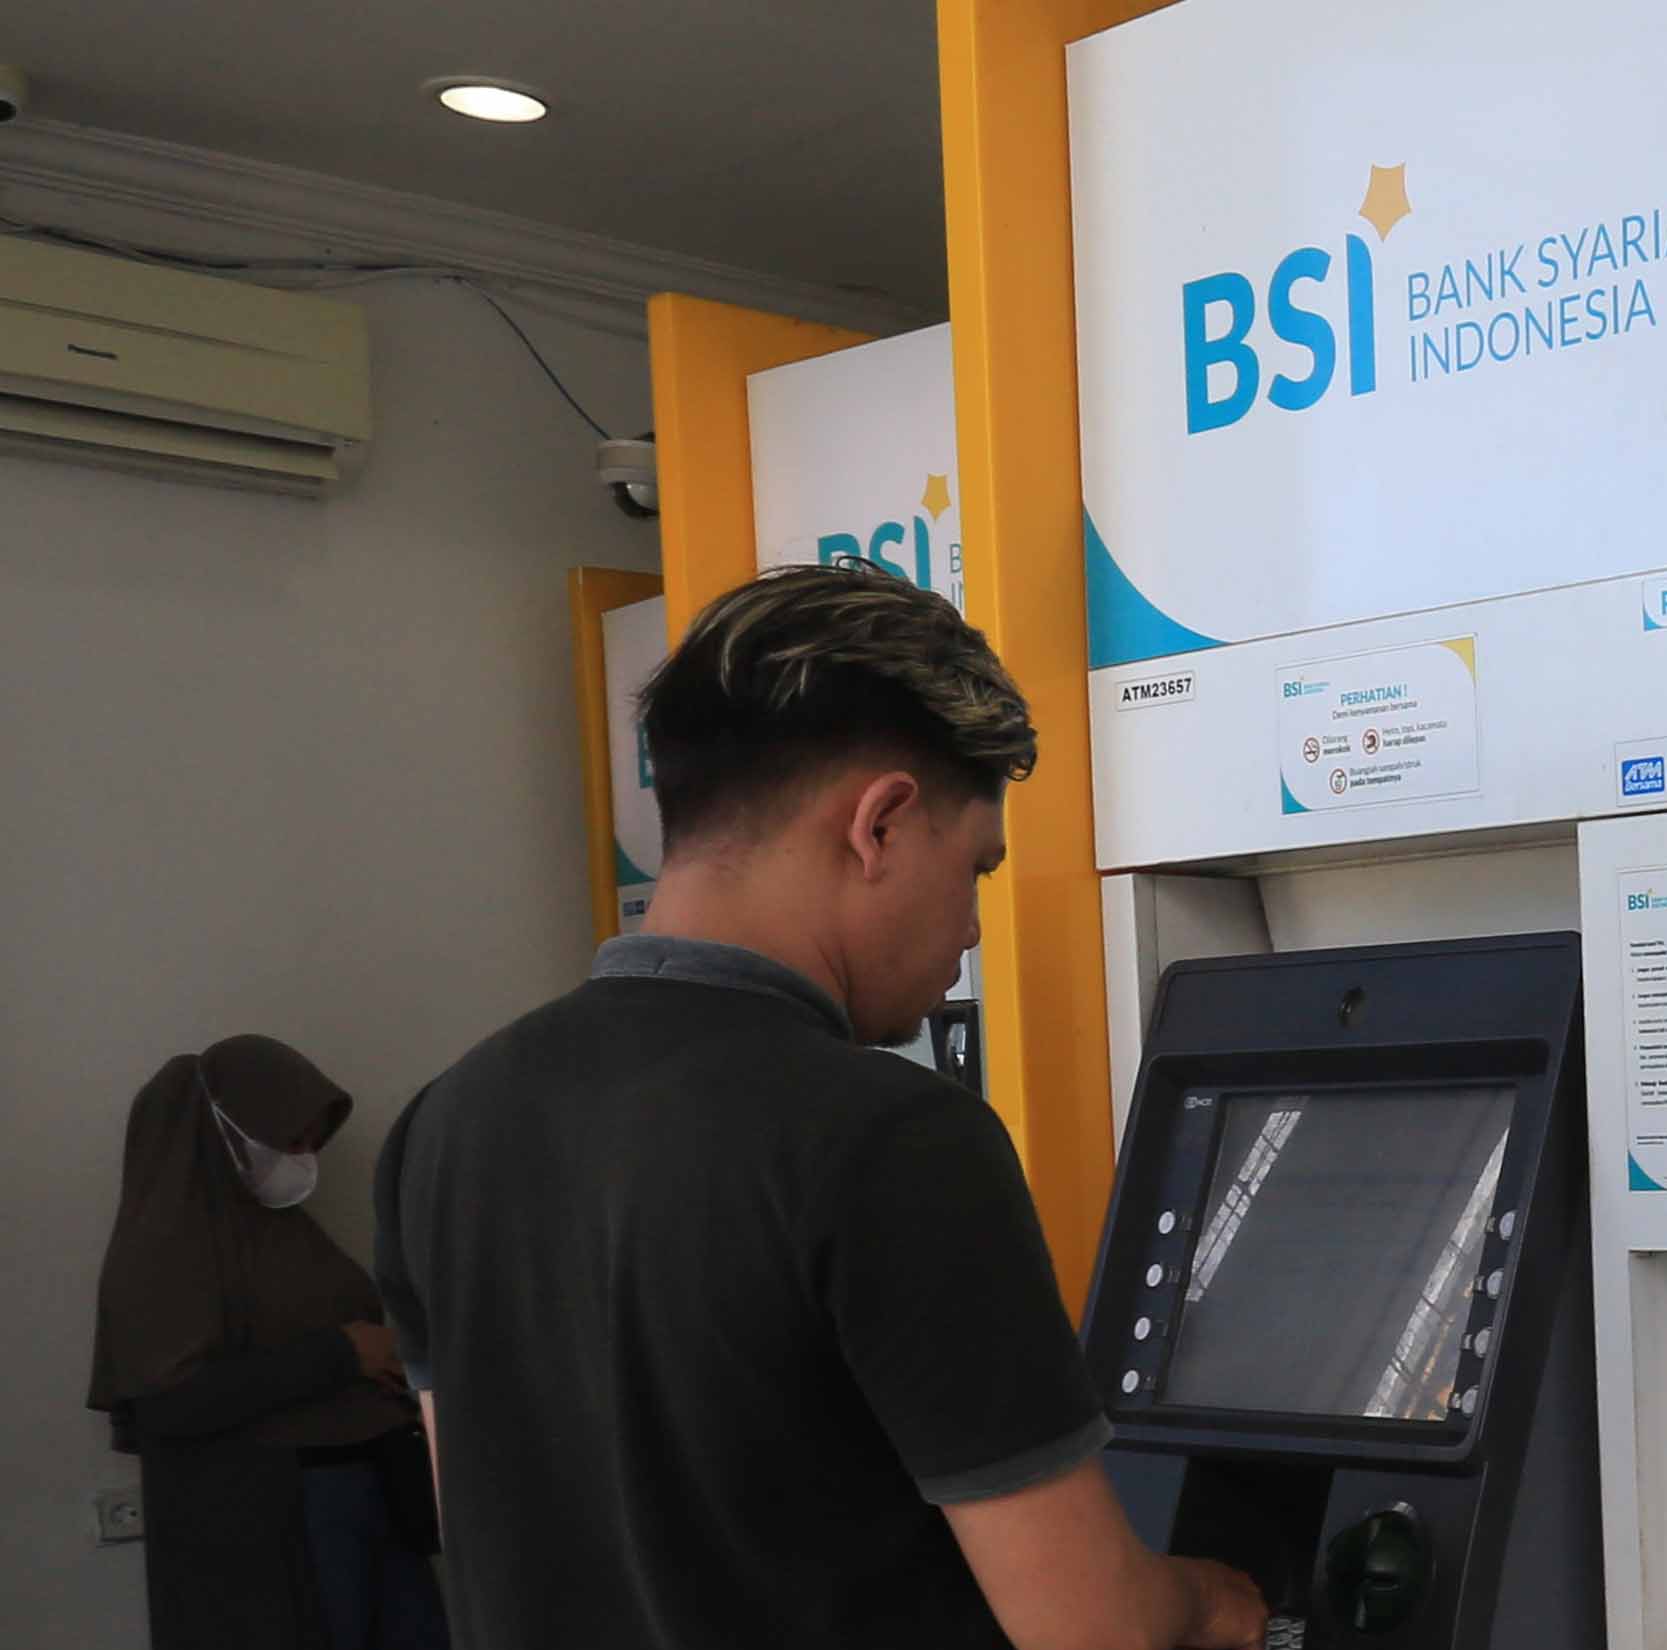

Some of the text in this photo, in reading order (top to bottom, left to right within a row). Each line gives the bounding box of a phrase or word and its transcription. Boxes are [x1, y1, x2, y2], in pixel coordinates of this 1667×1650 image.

[1407, 244, 1526, 321] BANK
[1182, 232, 1376, 435] BSI
[1410, 279, 1656, 382] INDONESIA
[1121, 677, 1192, 702] ATM23657
[1283, 681, 1302, 698] BSI
[1628, 894, 1649, 910] BSI
